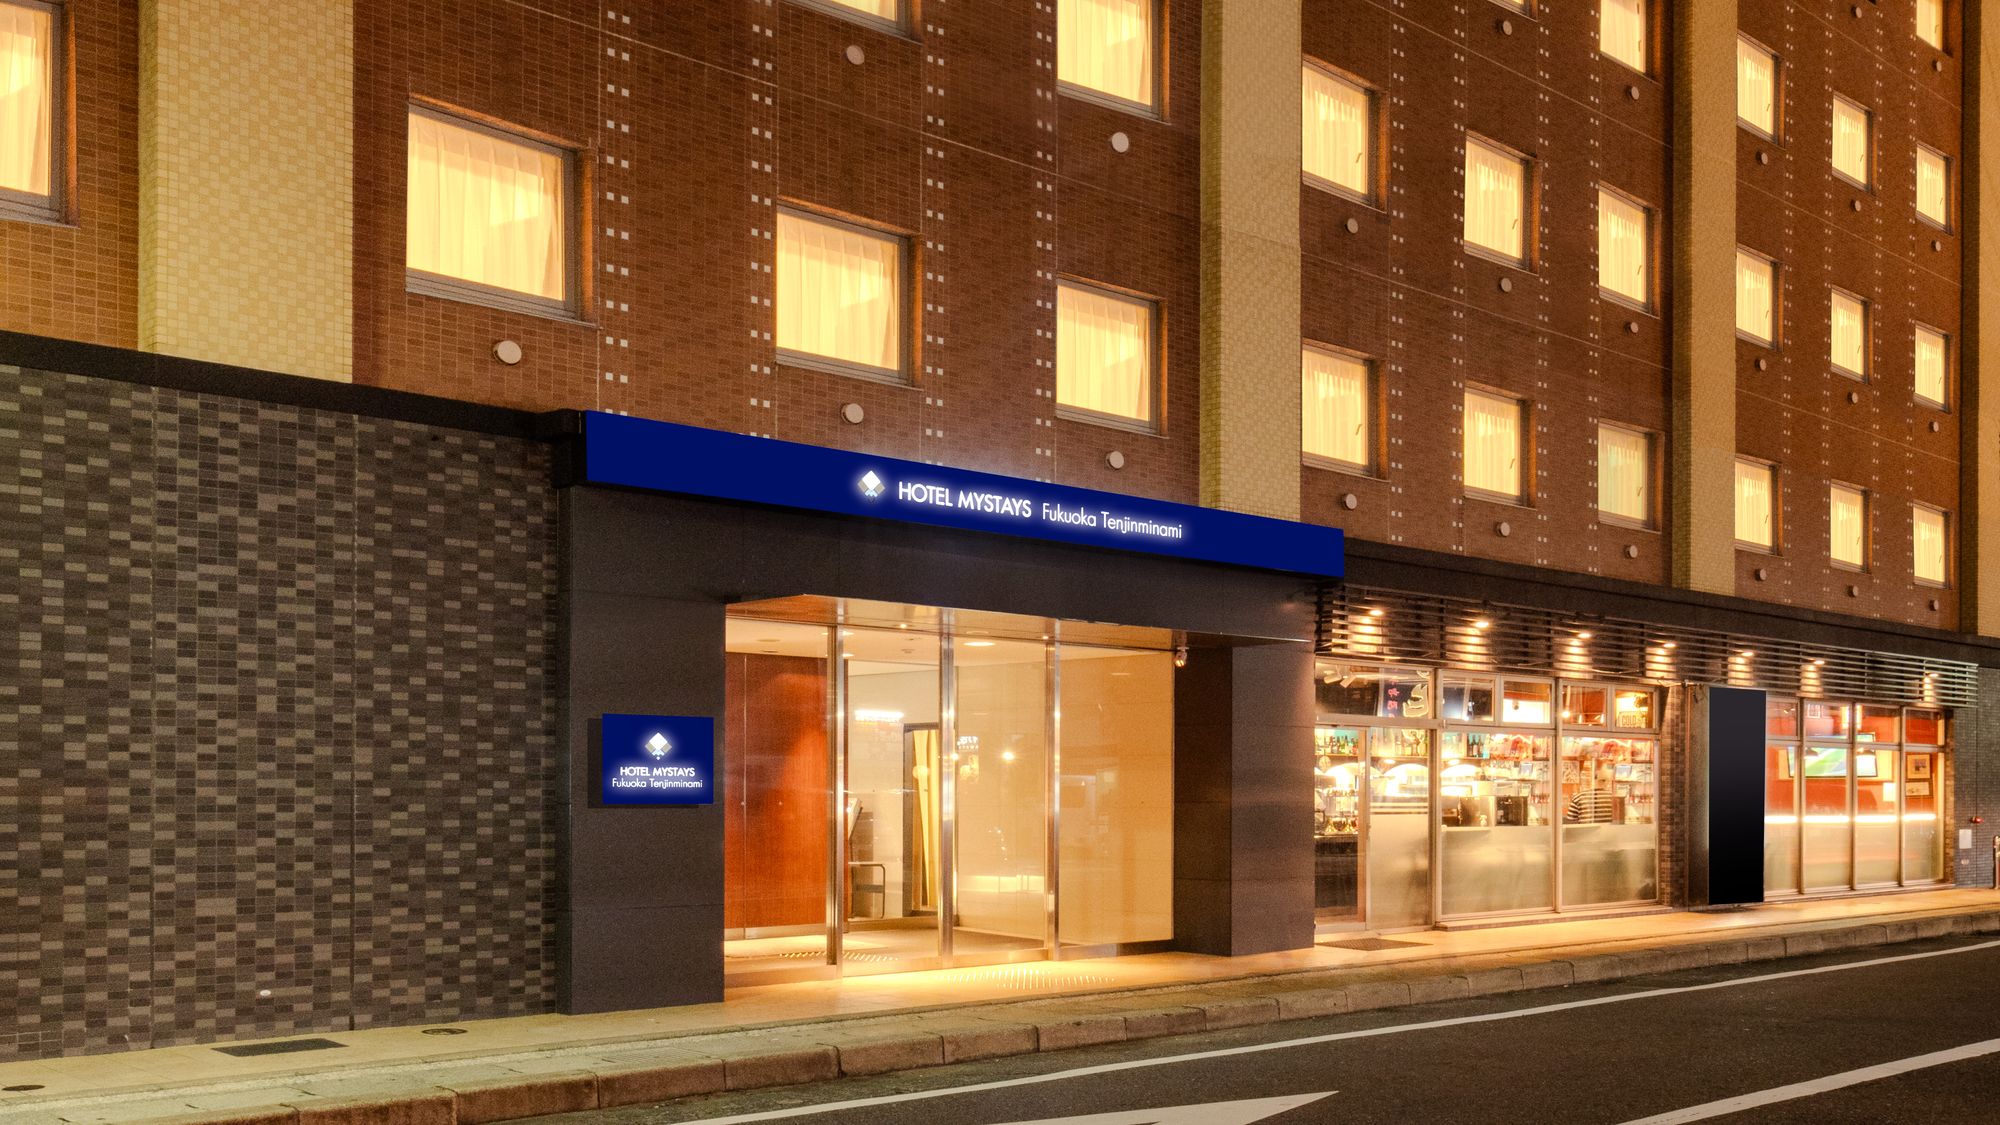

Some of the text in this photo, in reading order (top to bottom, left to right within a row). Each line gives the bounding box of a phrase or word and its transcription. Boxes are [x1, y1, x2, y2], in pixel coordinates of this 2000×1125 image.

[899, 482, 1183, 539] HOTEL MYSTAYS Fukuoka Tenjinminami
[620, 766, 696, 777] HOTEL MYSTAYS
[612, 778, 703, 789] Fukuoka Tenjinminami
